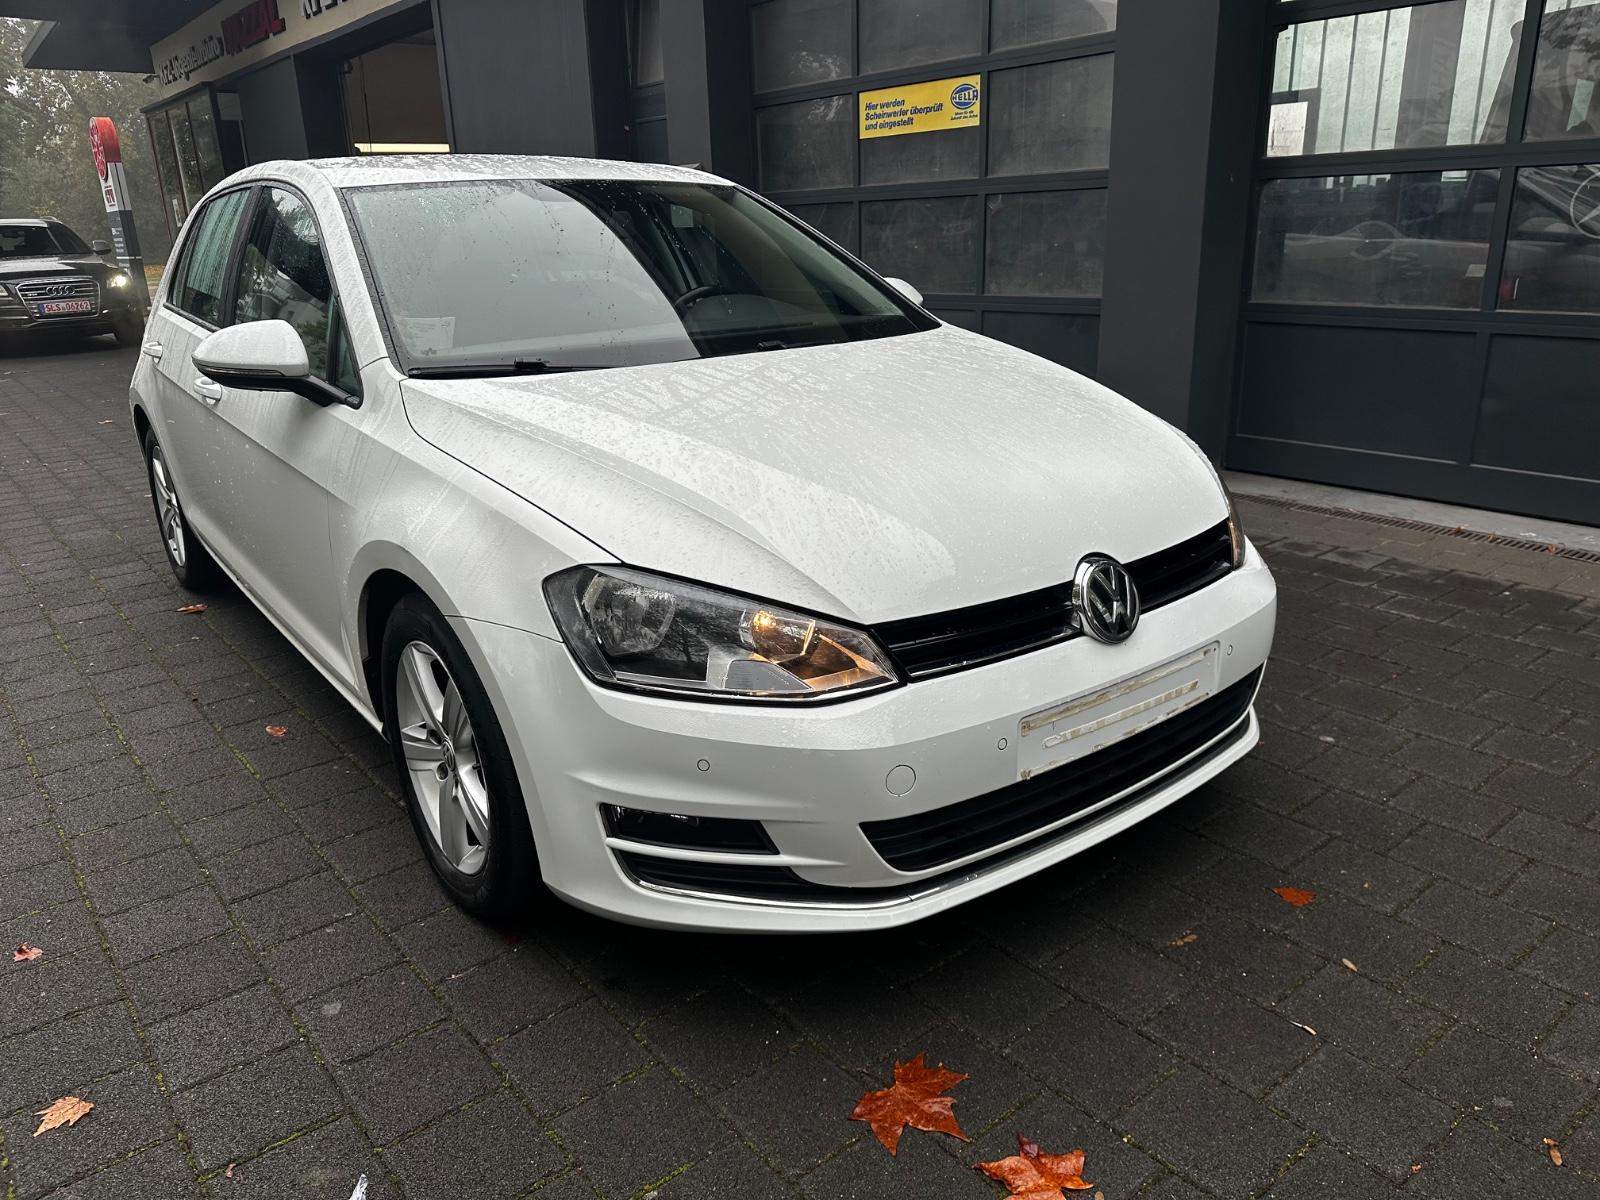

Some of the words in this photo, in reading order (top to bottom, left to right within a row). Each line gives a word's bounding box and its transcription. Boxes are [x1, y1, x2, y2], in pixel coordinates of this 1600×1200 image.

[952, 89, 979, 101] HELLA
[864, 102, 879, 111] Hier
[880, 98, 905, 110] werden
[864, 107, 909, 121] Scheinwerfer
[910, 102, 944, 115] überprüft
[864, 121, 878, 130] und
[879, 116, 914, 130] eingestellt
[46, 303, 61, 312] SLS
